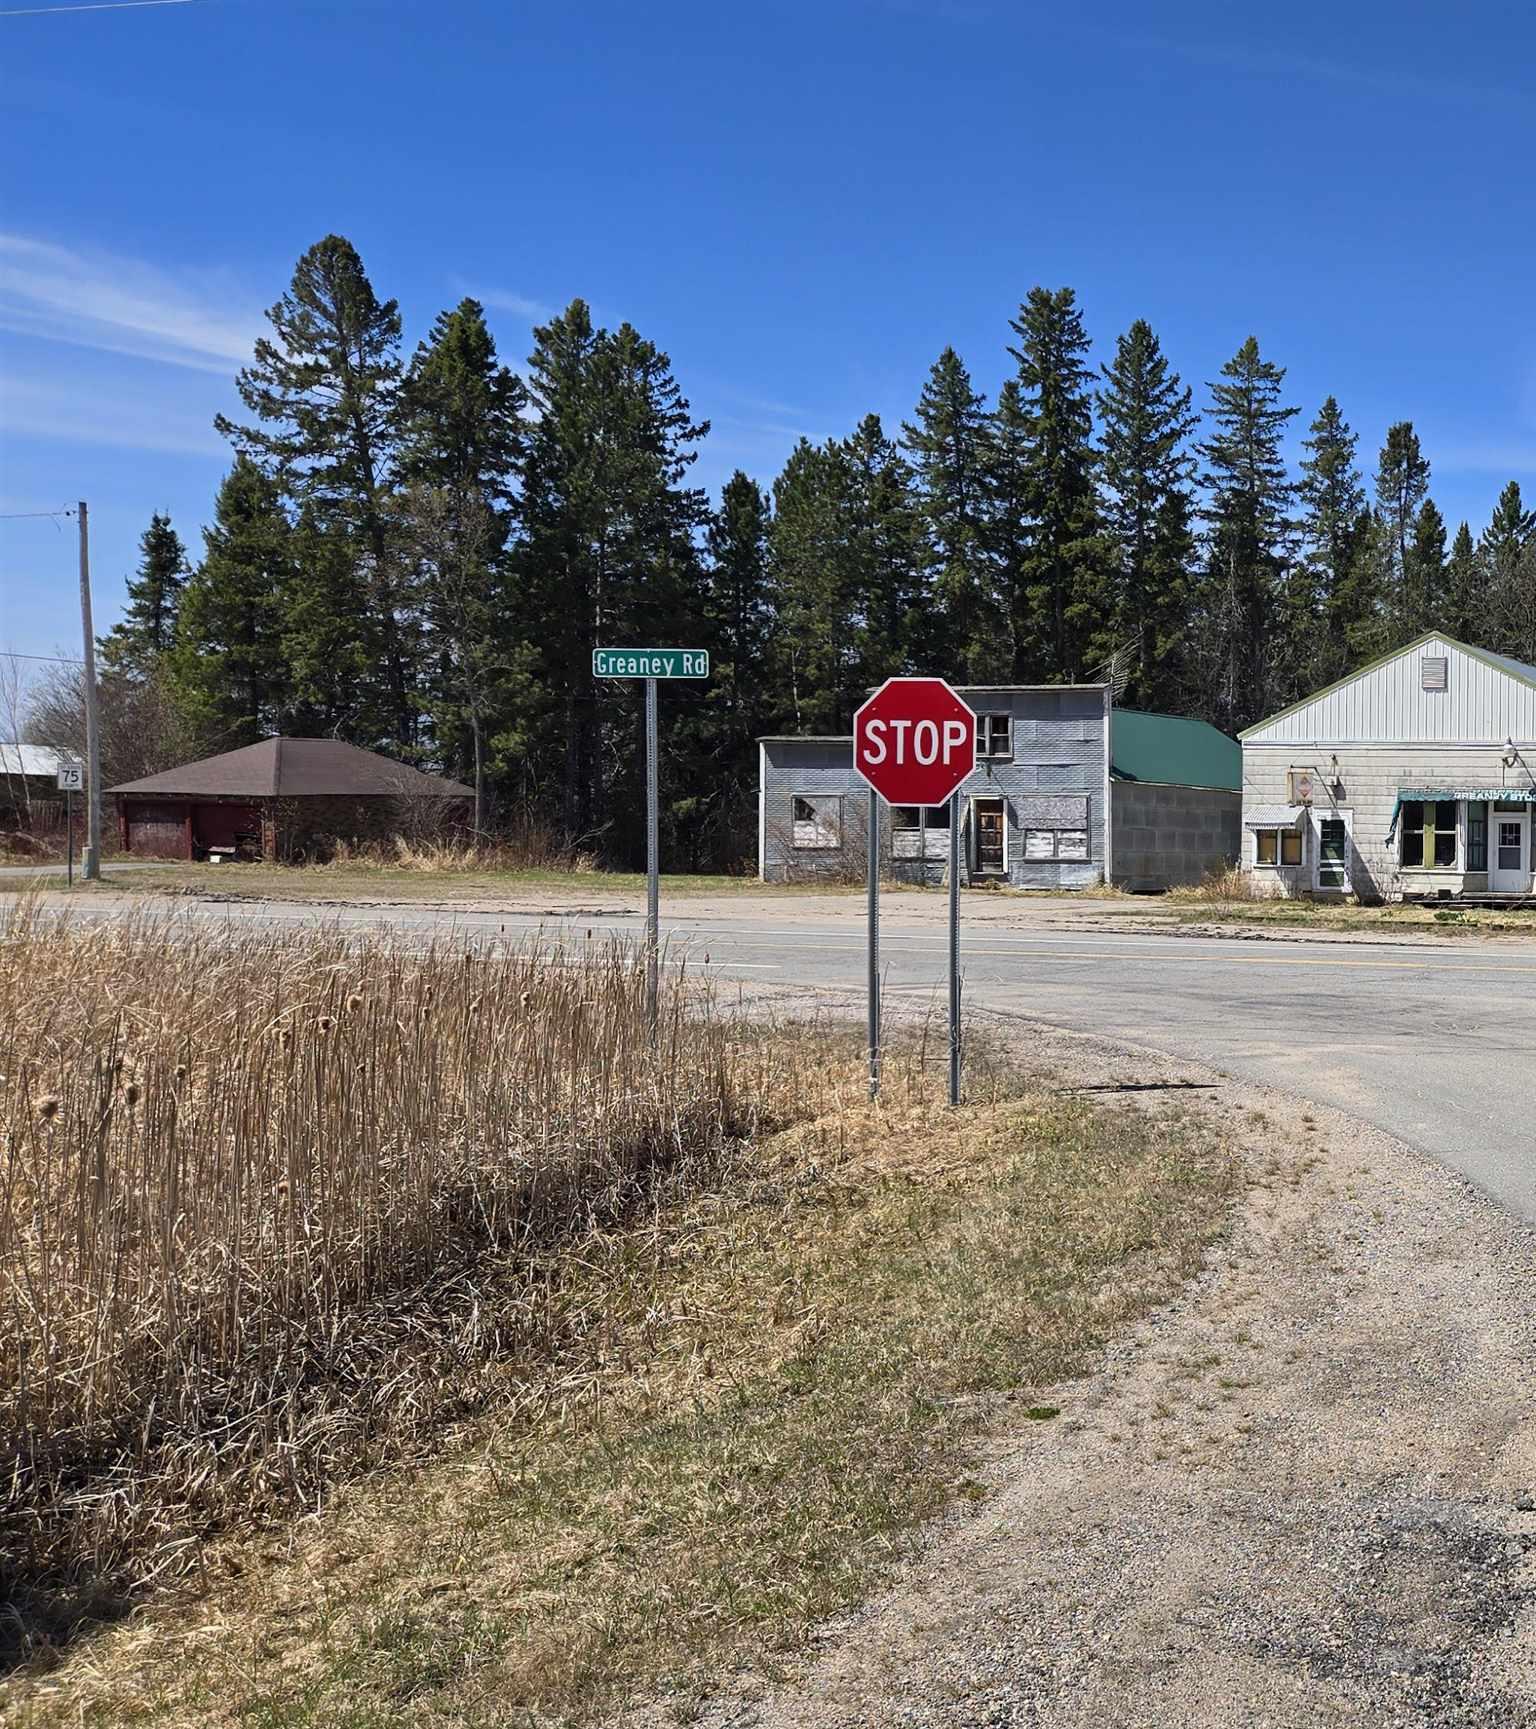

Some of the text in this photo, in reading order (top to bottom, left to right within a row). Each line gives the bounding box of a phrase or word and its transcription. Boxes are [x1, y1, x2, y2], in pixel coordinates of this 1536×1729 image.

[597, 653, 705, 676] Greaney Rd
[863, 719, 967, 765] STOP
[62, 770, 79, 783] 75
